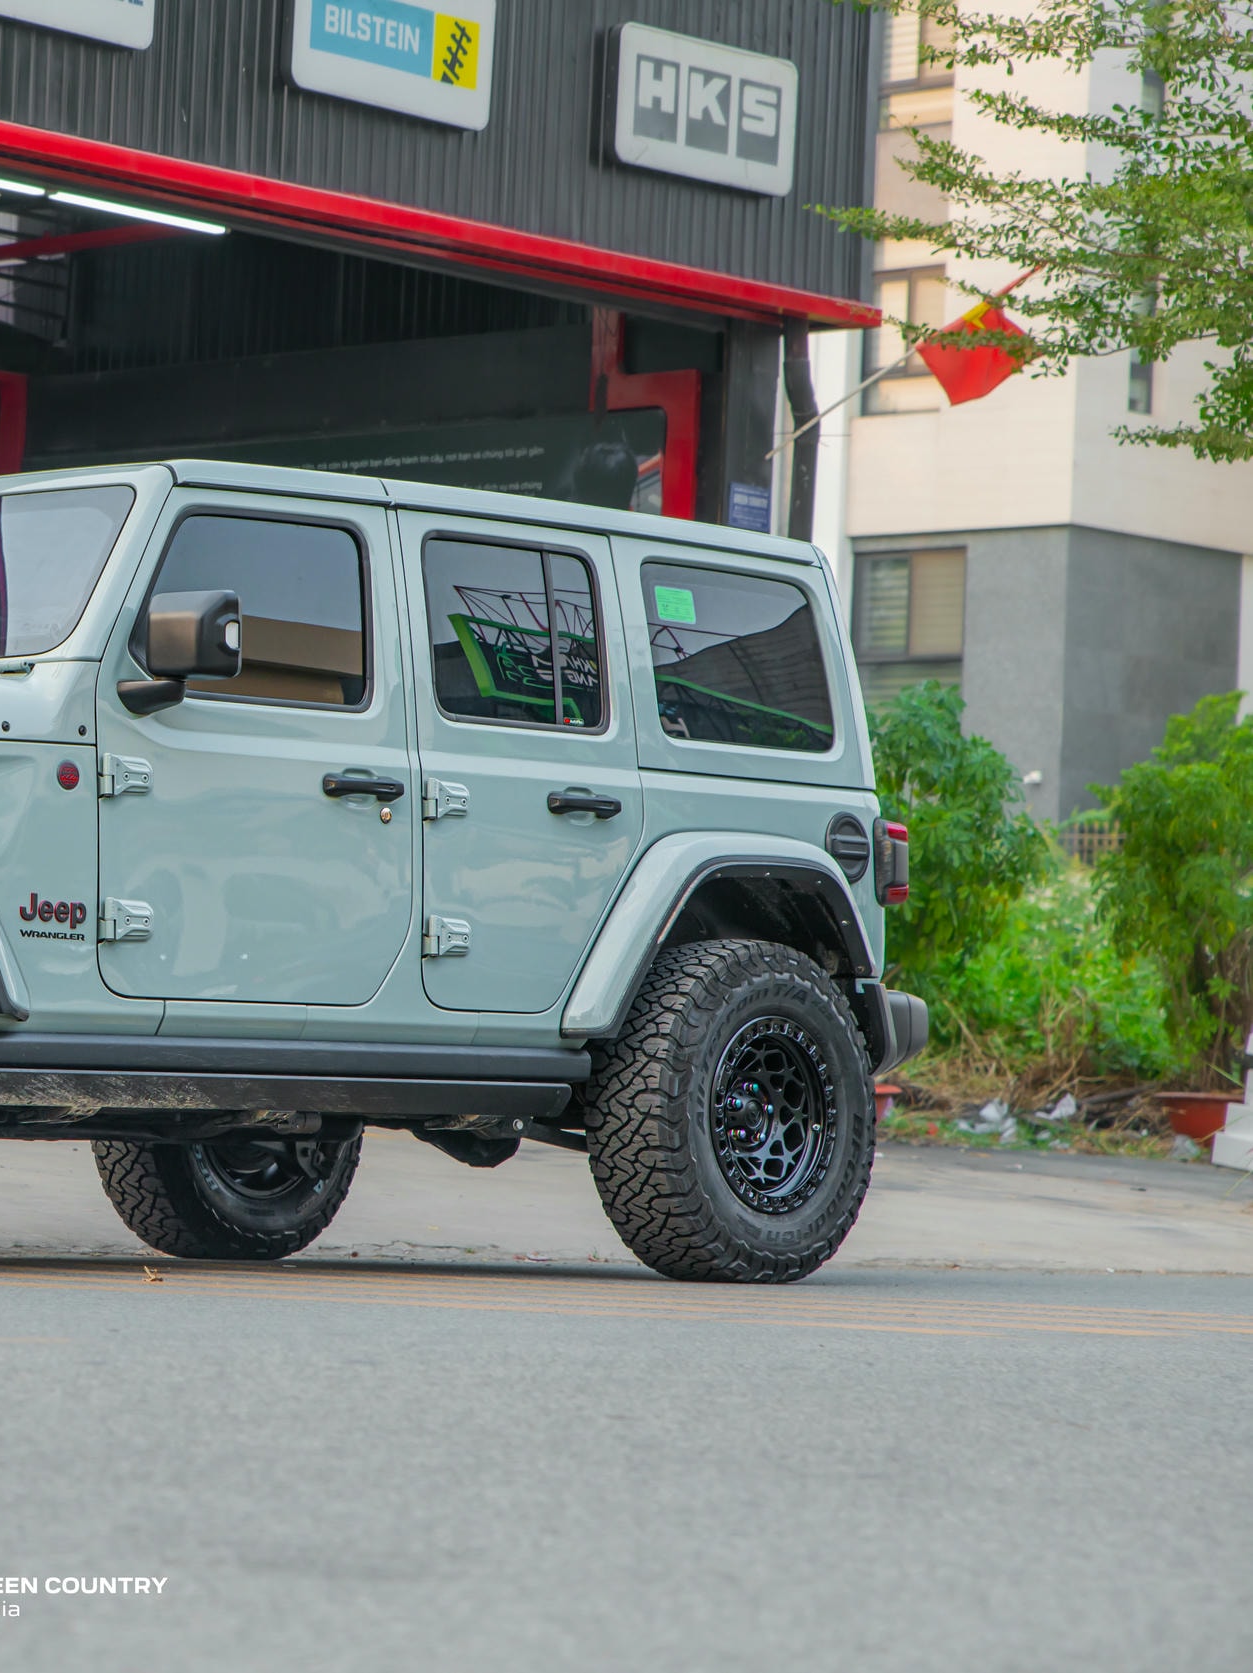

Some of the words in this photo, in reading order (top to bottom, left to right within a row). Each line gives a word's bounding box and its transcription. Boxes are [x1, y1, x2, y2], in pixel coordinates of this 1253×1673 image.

[325, 4, 420, 55] BILSTEIN
[637, 59, 778, 138] HKS
[19, 892, 87, 930] Jeep
[19, 929, 85, 941] WRANGLER
